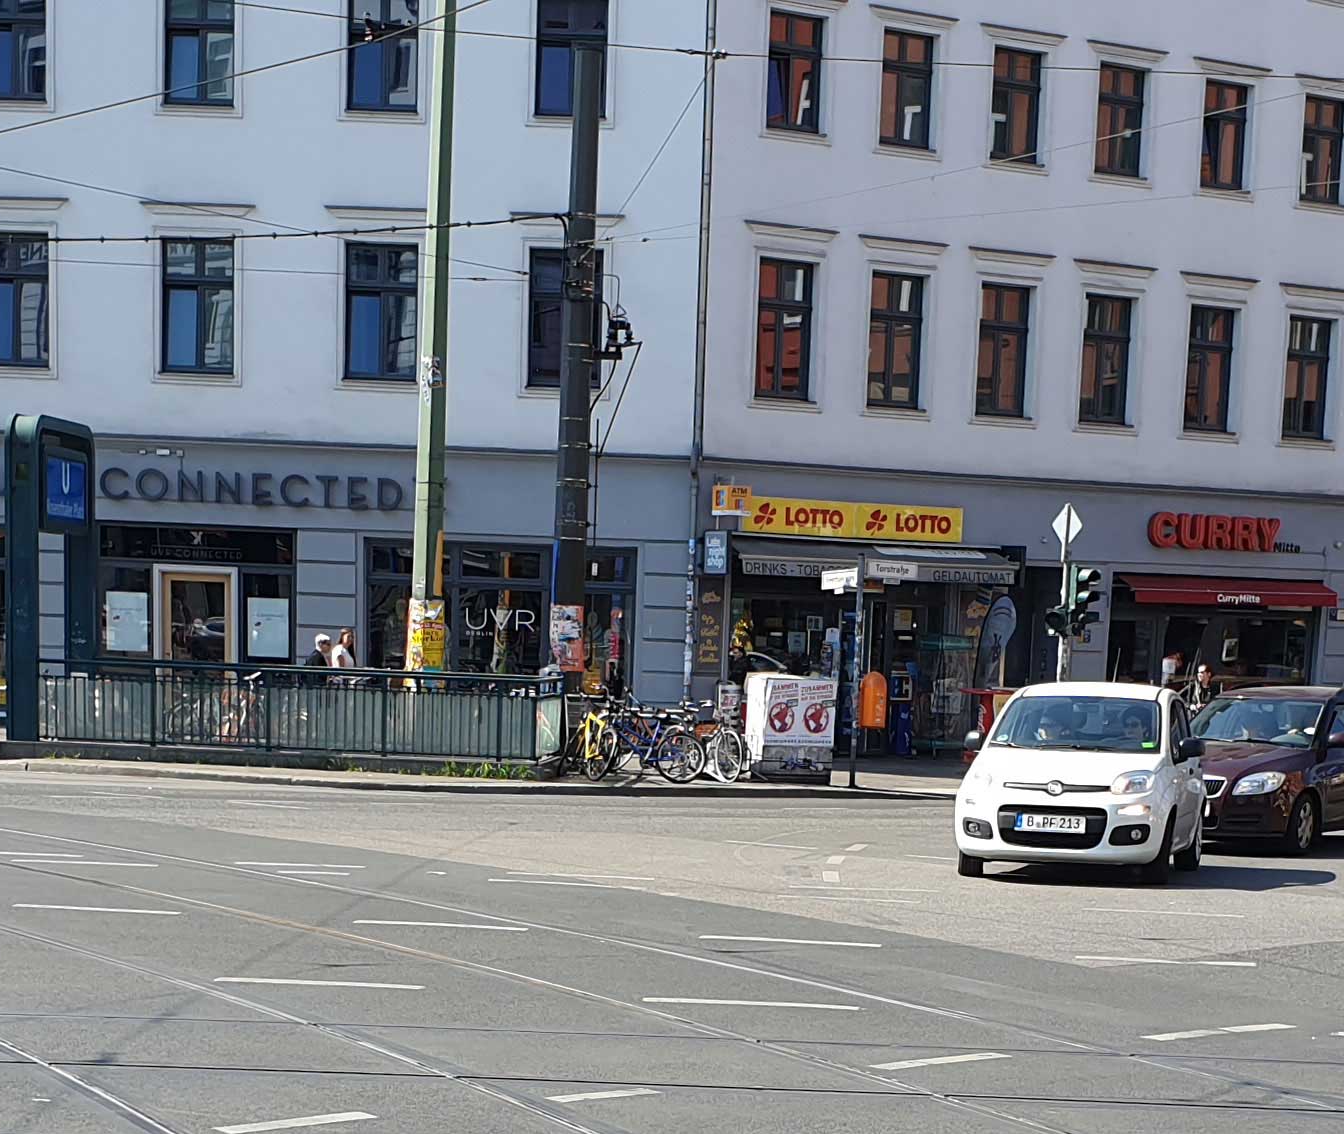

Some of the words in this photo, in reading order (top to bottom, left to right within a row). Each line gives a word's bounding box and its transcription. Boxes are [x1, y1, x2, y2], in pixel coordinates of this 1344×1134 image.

[62, 461, 70, 494] U
[99, 467, 404, 510] CONNECTED
[731, 487, 748, 495] ATM
[785, 507, 844, 529] LOTTO
[895, 513, 952, 534] LOTTO
[1147, 511, 1281, 551] CURRY
[1273, 542, 1301, 553] Mitte
[745, 562, 787, 576] DRINKS
[932, 570, 1013, 583] GELDAUTOMAT
[1217, 594, 1261, 604] CurryMitte
[465, 607, 536, 632] UVR
[1027, 816, 1034, 827] B
[1042, 816, 1056, 828] PF
[1059, 817, 1081, 829] 213
